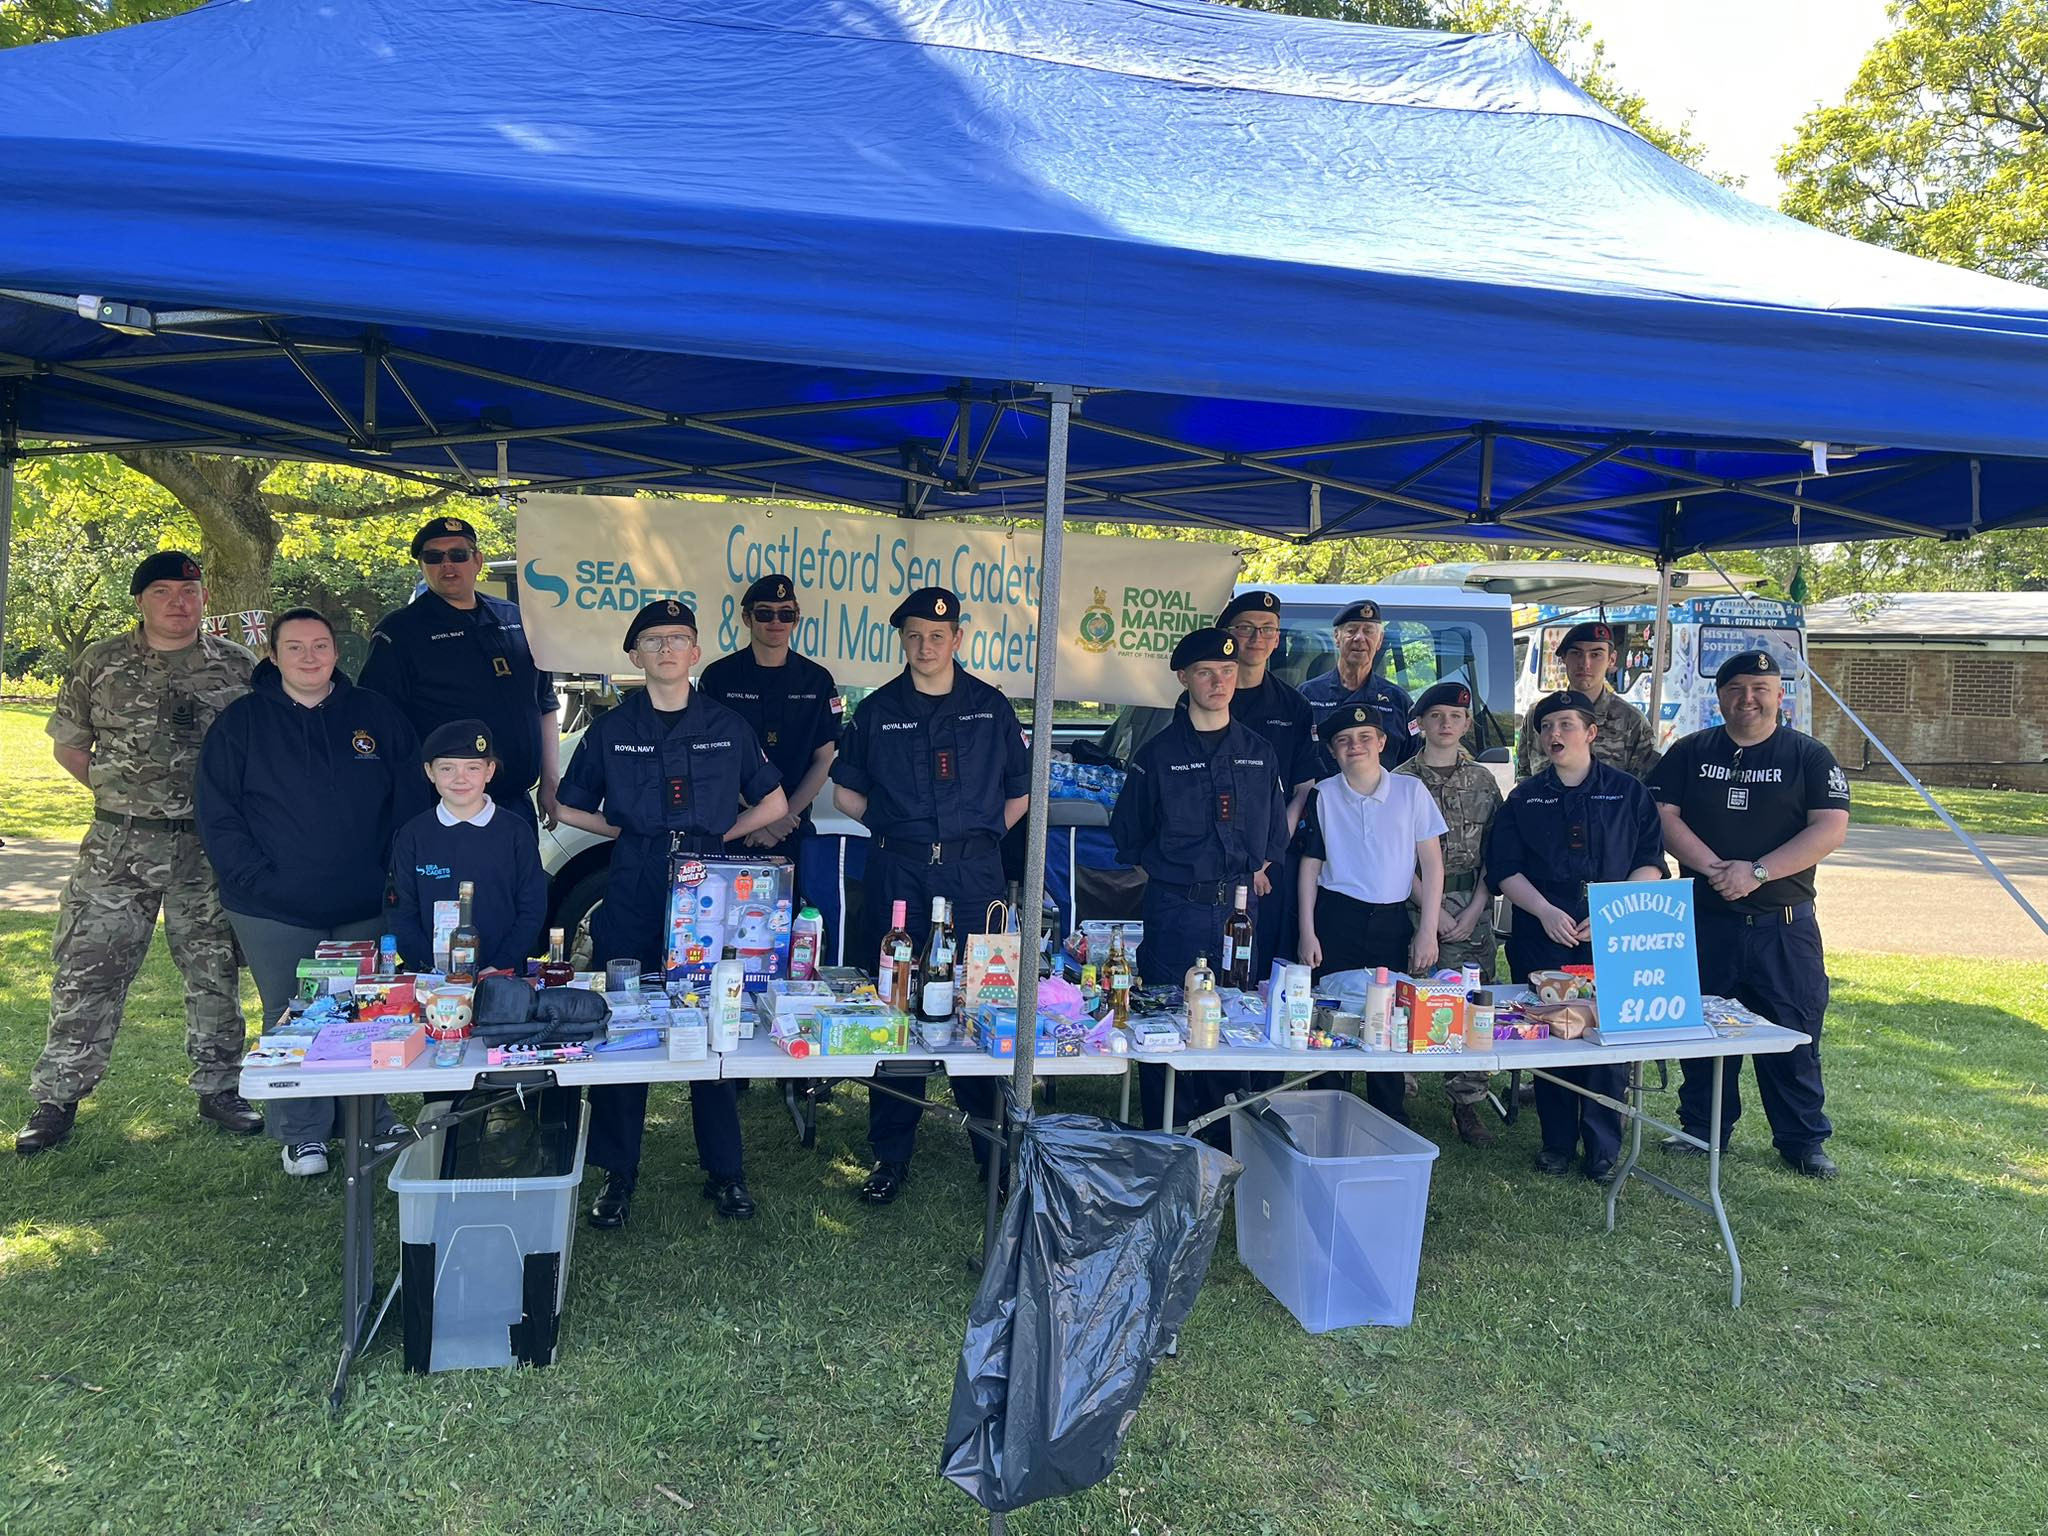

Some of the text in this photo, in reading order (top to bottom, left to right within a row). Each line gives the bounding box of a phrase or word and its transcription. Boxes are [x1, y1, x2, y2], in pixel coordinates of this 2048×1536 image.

[726, 523, 881, 594] Castleford
[889, 538, 941, 597] Sea
[575, 560, 636, 586] SEA
[1123, 586, 1197, 611] ROYAL
[1740, 608, 1783, 616] CREAM
[718, 595, 739, 652] &
[953, 612, 1036, 674] Cadet
[1119, 630, 1184, 653] CADE
[1703, 629, 1745, 640] MISTER
[1702, 642, 1745, 652] SOFTEE
[958, 712, 994, 722] CADET FORCES
[882, 721, 918, 731] ROYAL NAVY
[614, 744, 655, 754] ROYAL NAVY
[710, 741, 731, 749] FORCES
[1171, 762, 1206, 772] ROYAL NAVY
[1699, 763, 1783, 783] SUBMRINER
[425, 867, 451, 876] CADETS
[1599, 892, 1688, 925] TOMBOLA
[1607, 932, 1686, 953] 5 TICKETS
[687, 973, 709, 981] SPACE
[1633, 968, 1665, 987] FOR
[1618, 995, 1686, 1023] £1.00
